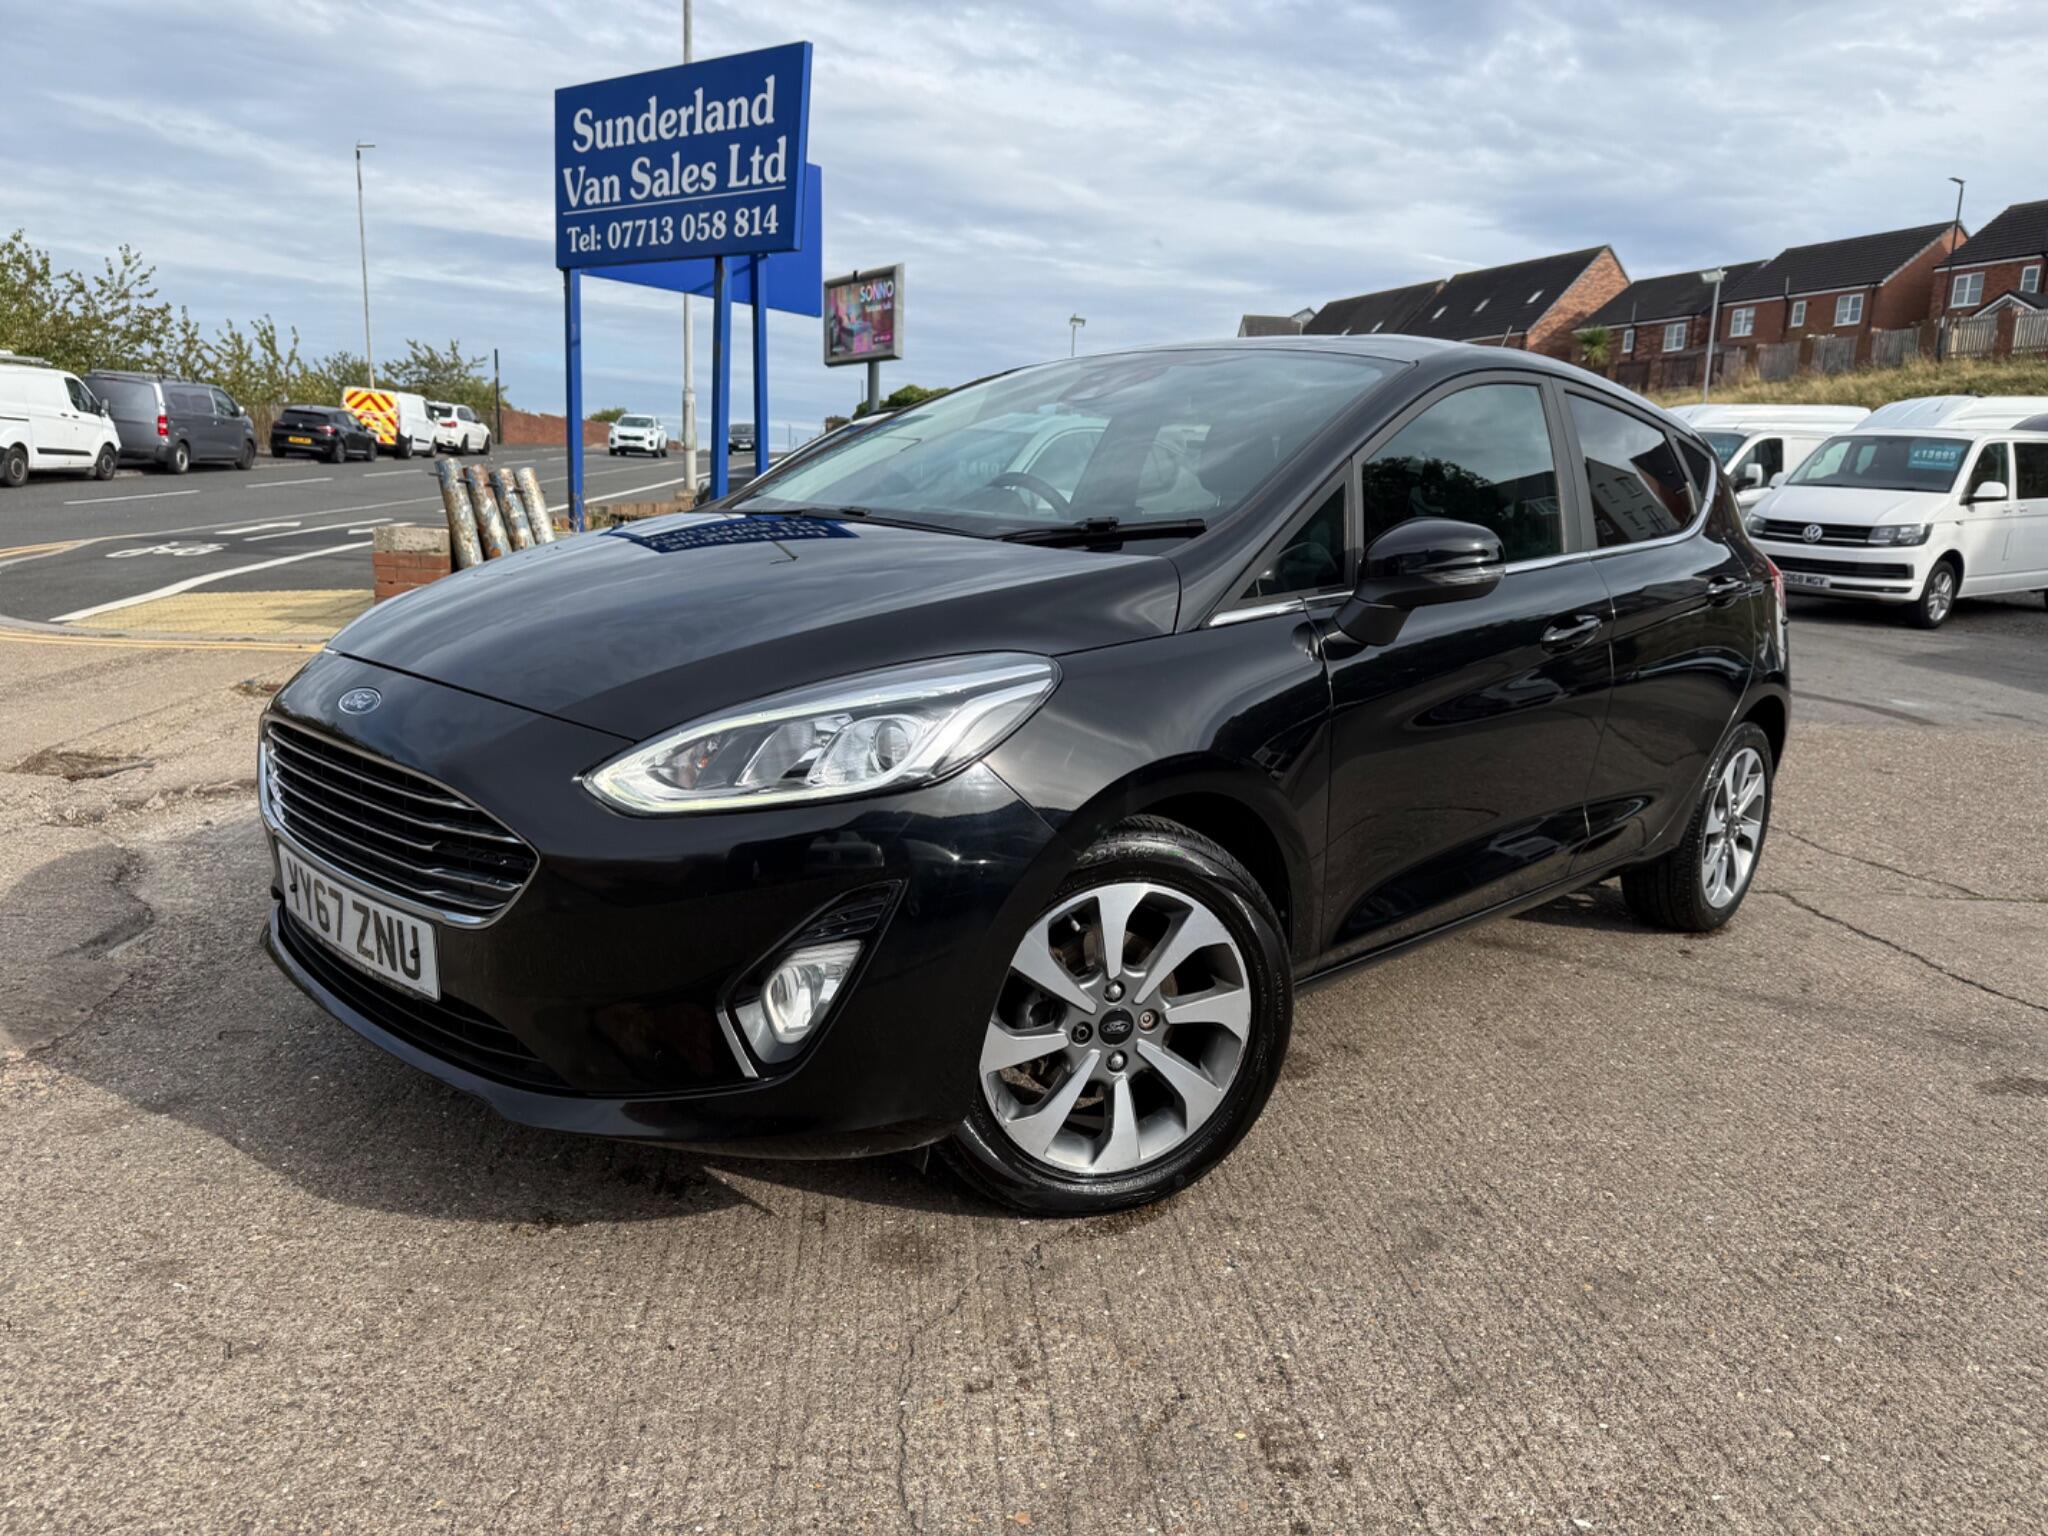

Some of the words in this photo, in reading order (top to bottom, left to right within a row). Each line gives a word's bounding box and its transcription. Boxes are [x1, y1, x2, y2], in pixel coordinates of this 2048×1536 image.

[572, 75, 775, 152] Sunderland
[563, 166, 621, 207] Van
[630, 151, 716, 200] Sales
[727, 135, 787, 188] Ltd
[567, 224, 601, 253] Tel:
[607, 216, 674, 249] 07713
[681, 210, 727, 242] 058
[734, 204, 779, 237] 814
[286, 856, 344, 943] YY67
[352, 900, 421, 981] ZNU
